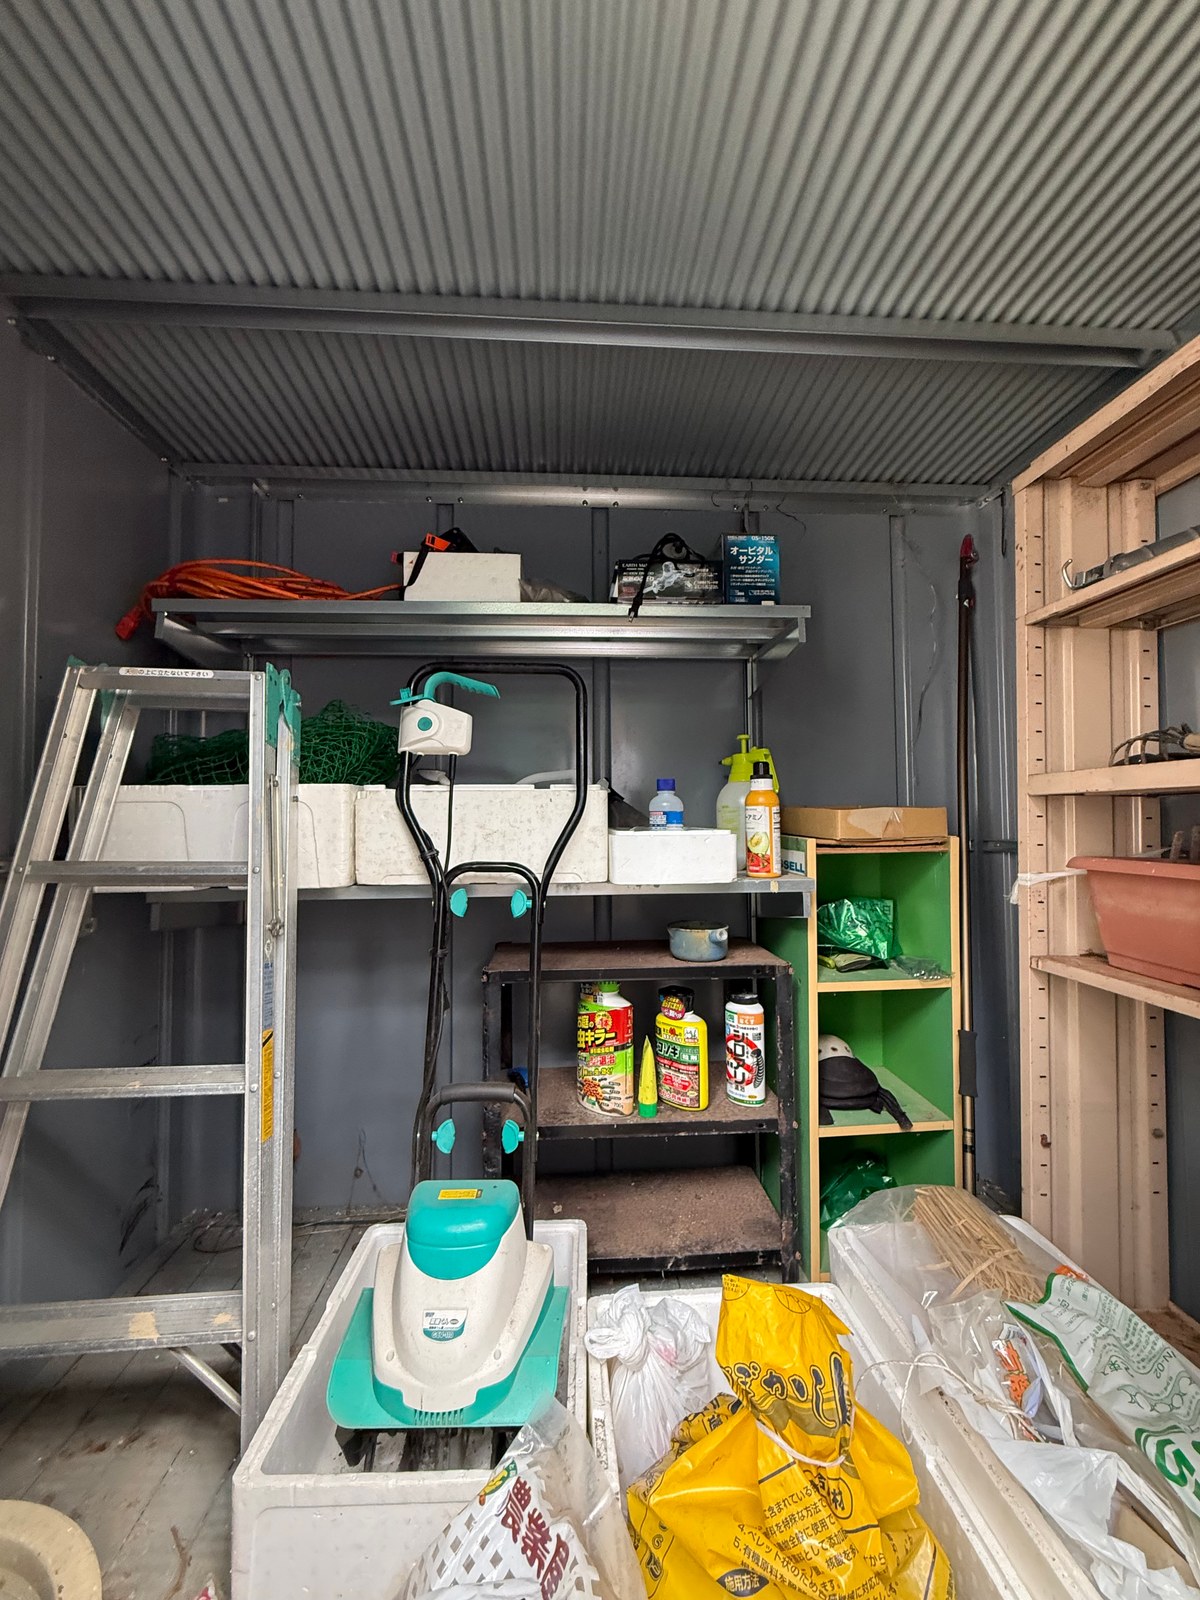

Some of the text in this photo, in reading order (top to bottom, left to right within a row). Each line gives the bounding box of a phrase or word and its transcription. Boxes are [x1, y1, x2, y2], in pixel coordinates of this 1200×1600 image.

[730, 546, 773, 556] オービタル
[738, 555, 774, 565] サンダー
[781, 858, 806, 874] SELL
[724, 1573, 760, 1593] 施用方法
